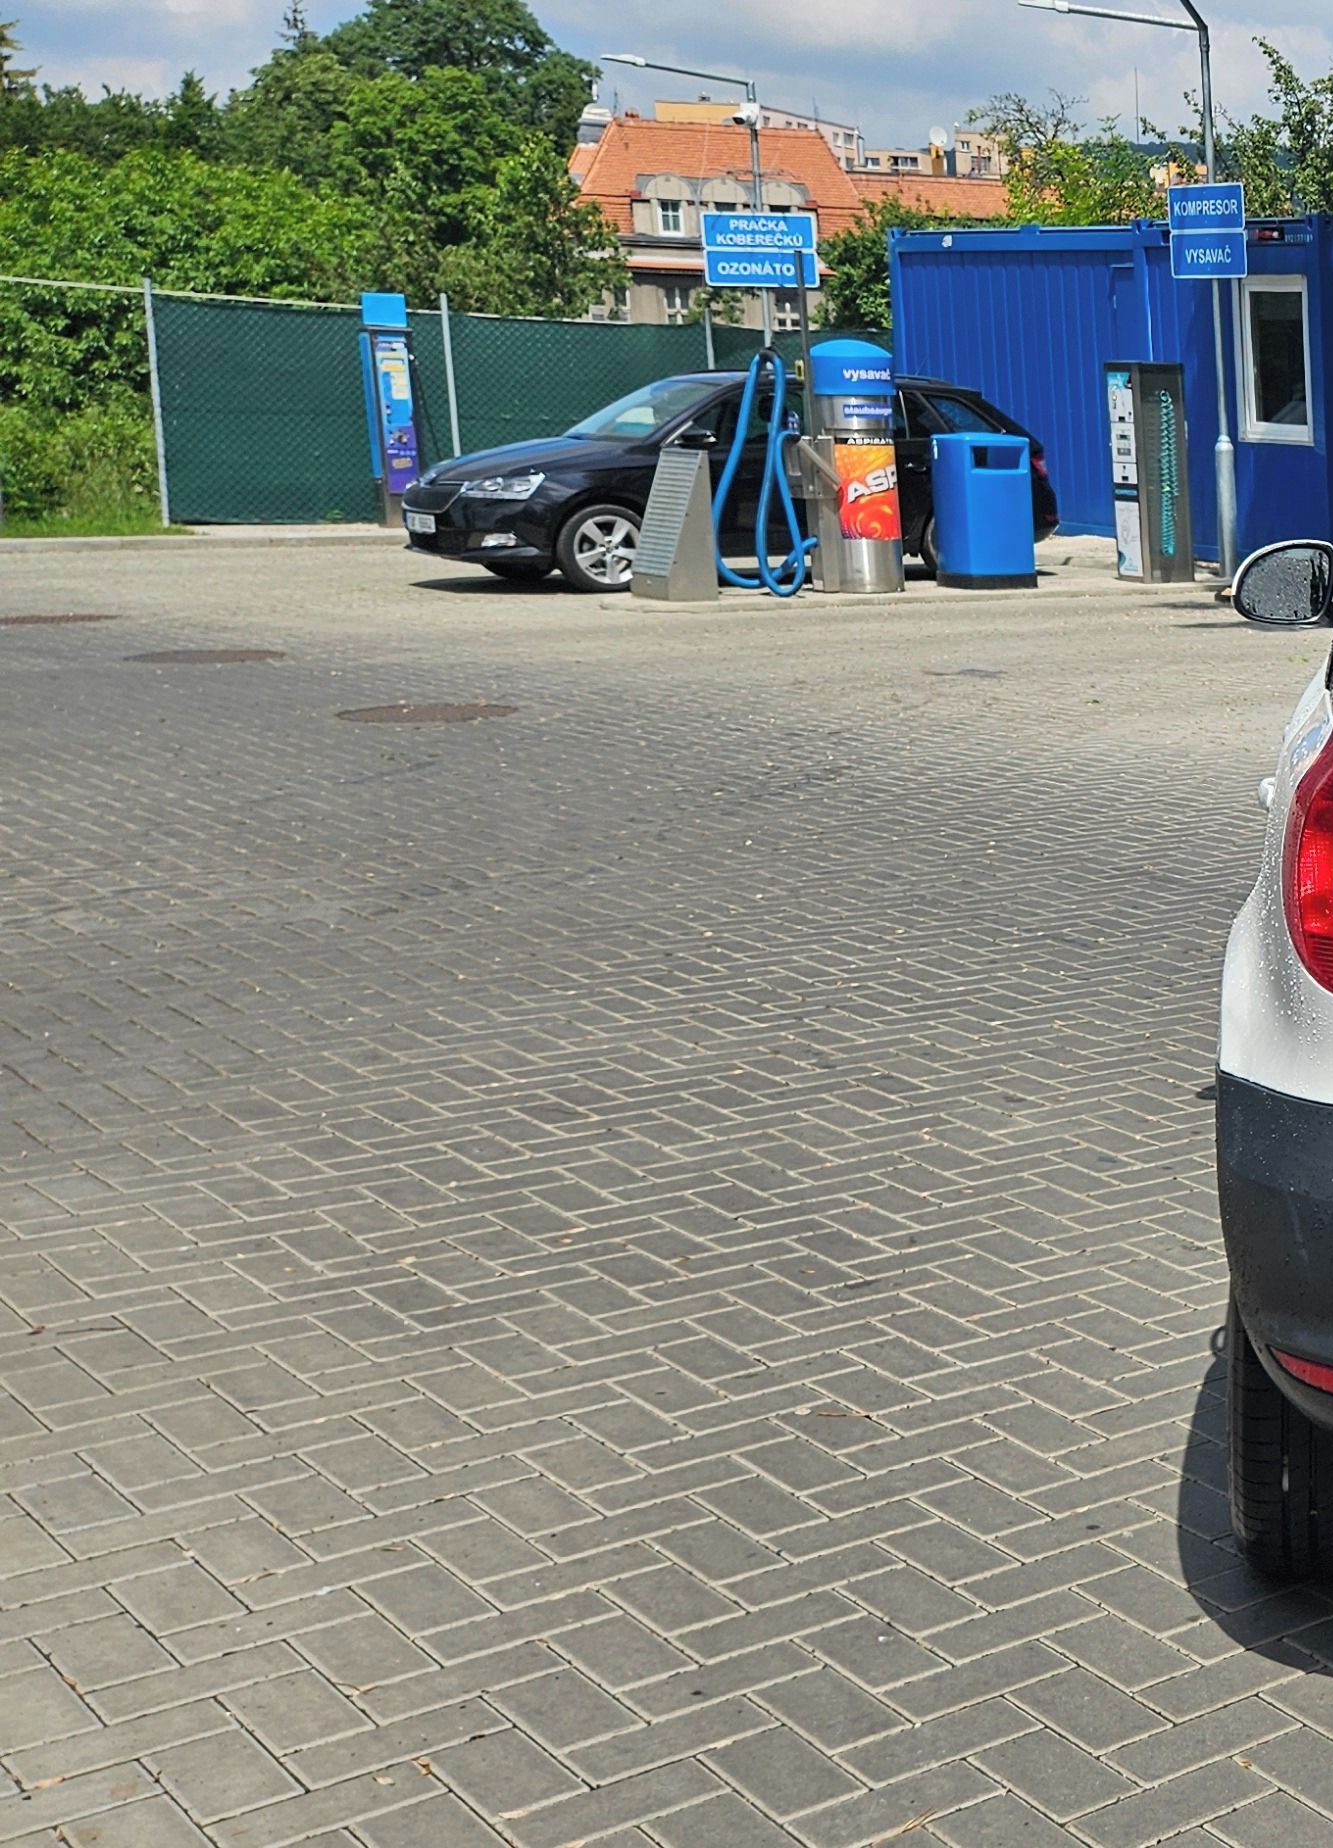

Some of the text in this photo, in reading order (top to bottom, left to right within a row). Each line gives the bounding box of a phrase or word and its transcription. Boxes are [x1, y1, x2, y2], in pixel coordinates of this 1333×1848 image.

[1173, 199, 1239, 216] KOMPRESOR
[729, 217, 788, 231] PRAČKA
[716, 232, 803, 247] KOBEREČKŮ
[1185, 244, 1232, 264] VYSAVAČ
[717, 261, 796, 276] OZONÁTO
